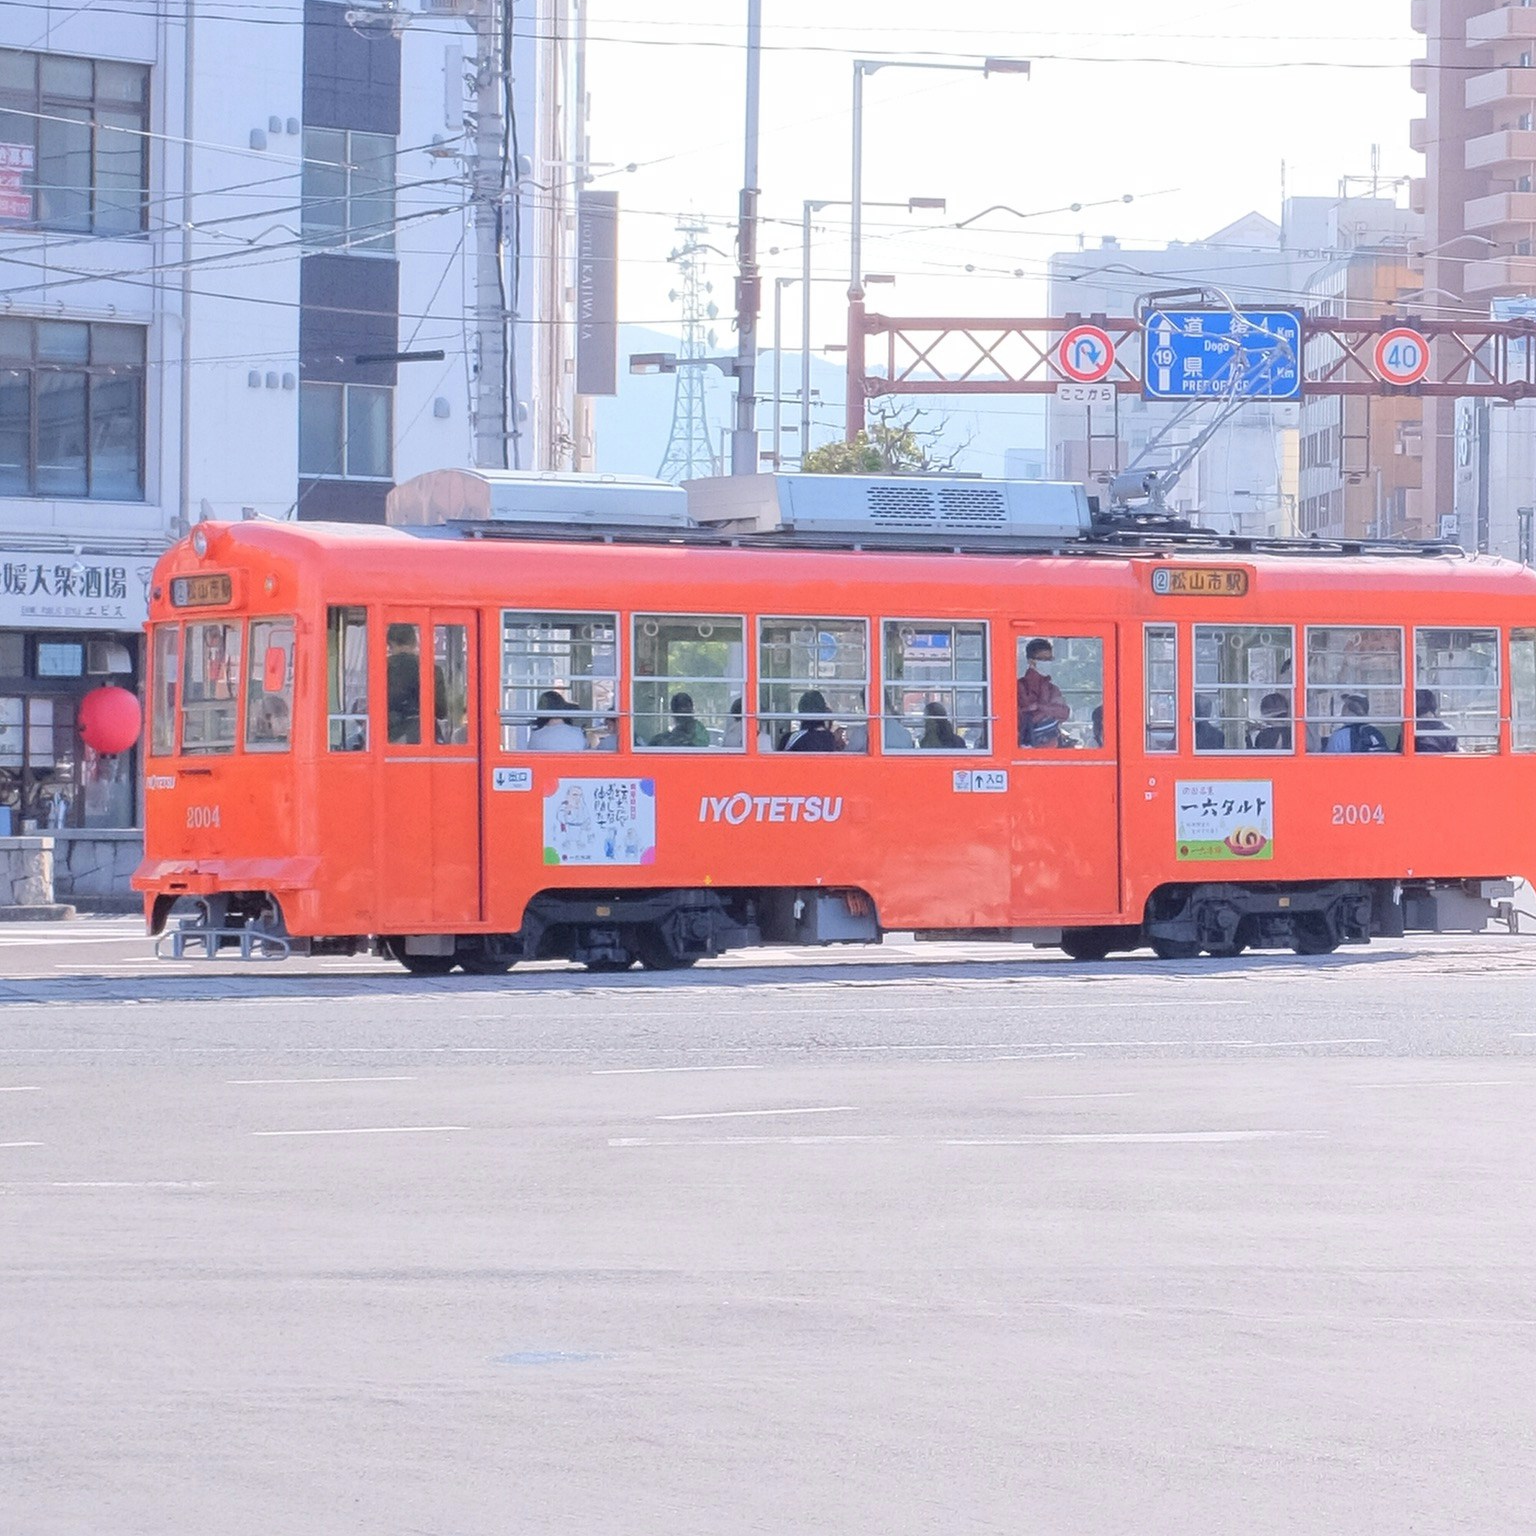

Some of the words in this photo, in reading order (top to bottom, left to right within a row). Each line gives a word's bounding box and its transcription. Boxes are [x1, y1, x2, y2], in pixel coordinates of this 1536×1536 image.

[1276, 326, 1295, 339] Km
[1204, 339, 1230, 355] Dogo
[1387, 344, 1417, 368] 40
[1155, 350, 1173, 365] 19
[1061, 388, 1112, 401] ここから
[0, 562, 127, 599] 媛大衆酒場
[1171, 571, 1241, 591] 松山市駅
[986, 773, 1004, 784] 入口
[186, 805, 221, 829] 2004
[698, 792, 843, 825] IYOTETSU
[1180, 797, 1266, 817] 一六タルト
[1331, 803, 1385, 825] 2004
